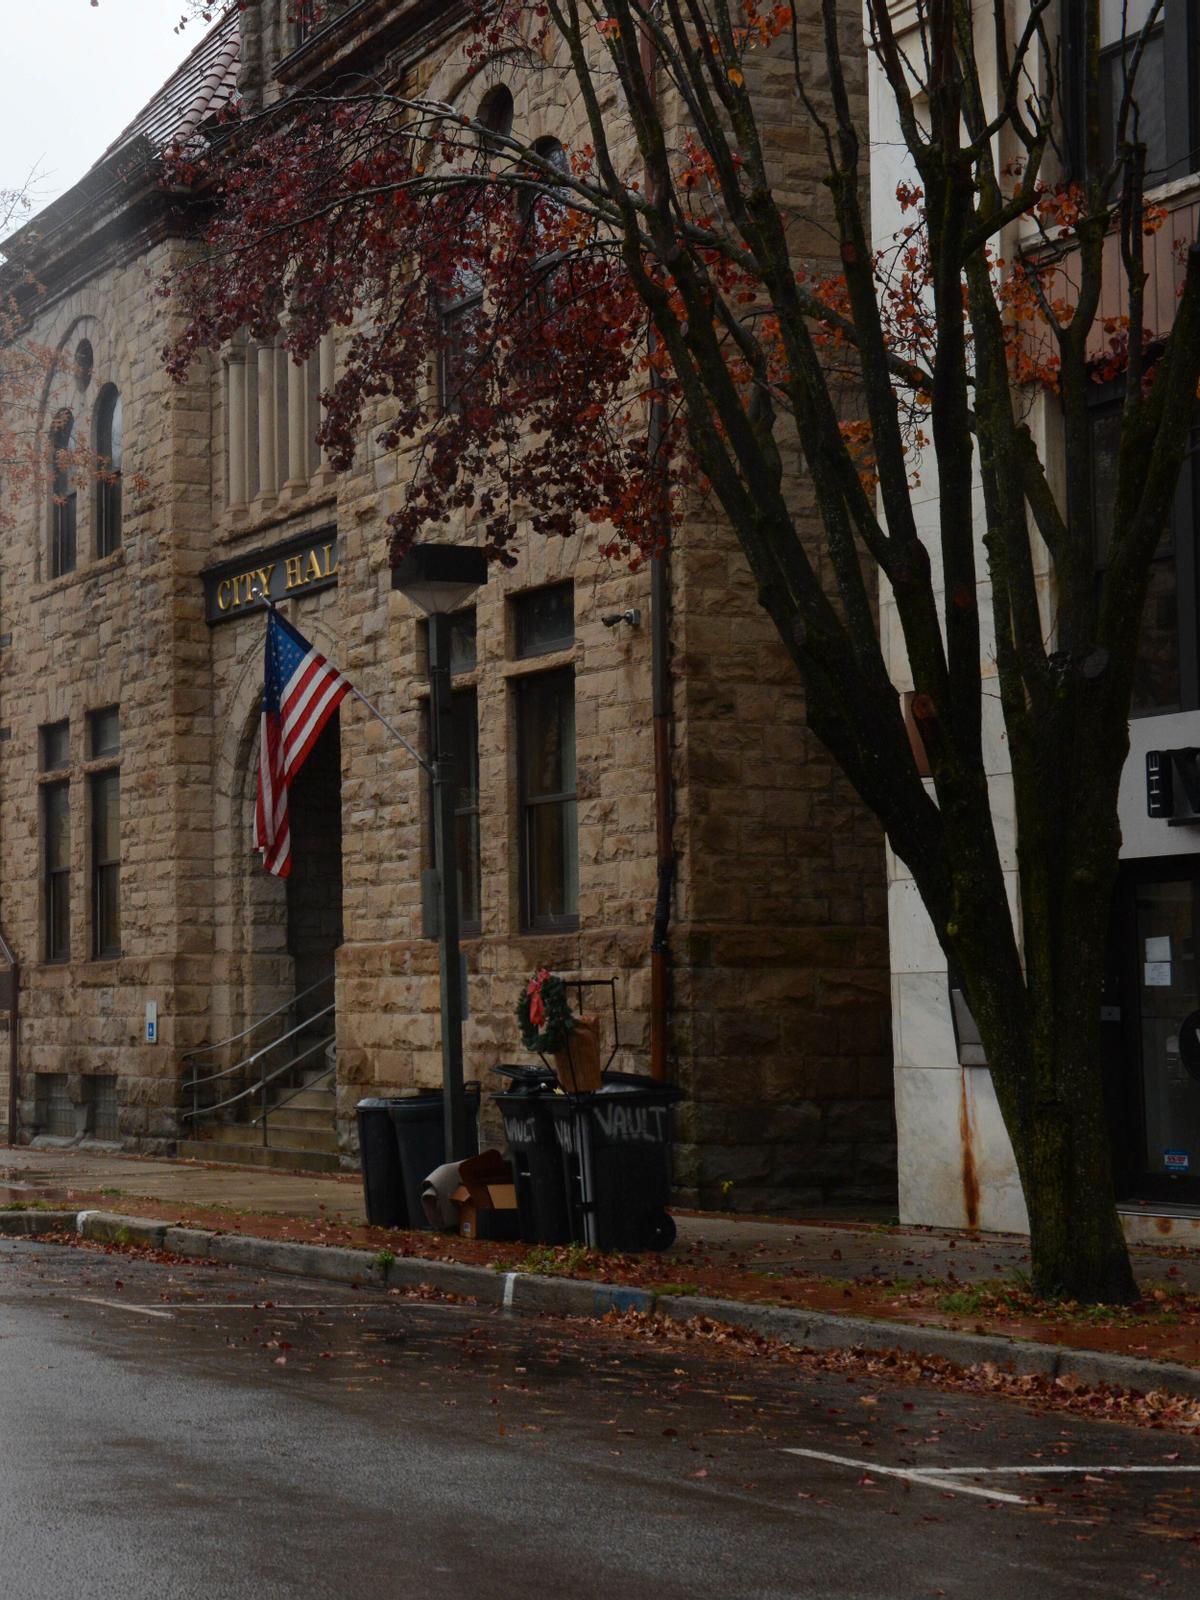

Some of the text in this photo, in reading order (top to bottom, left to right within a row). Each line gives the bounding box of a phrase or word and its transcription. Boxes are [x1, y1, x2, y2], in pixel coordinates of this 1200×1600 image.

[217, 544, 338, 609] CITY HAL
[1148, 752, 1161, 815] THE
[503, 1116, 535, 1143] VAULT
[592, 1102, 667, 1143] VAULT
